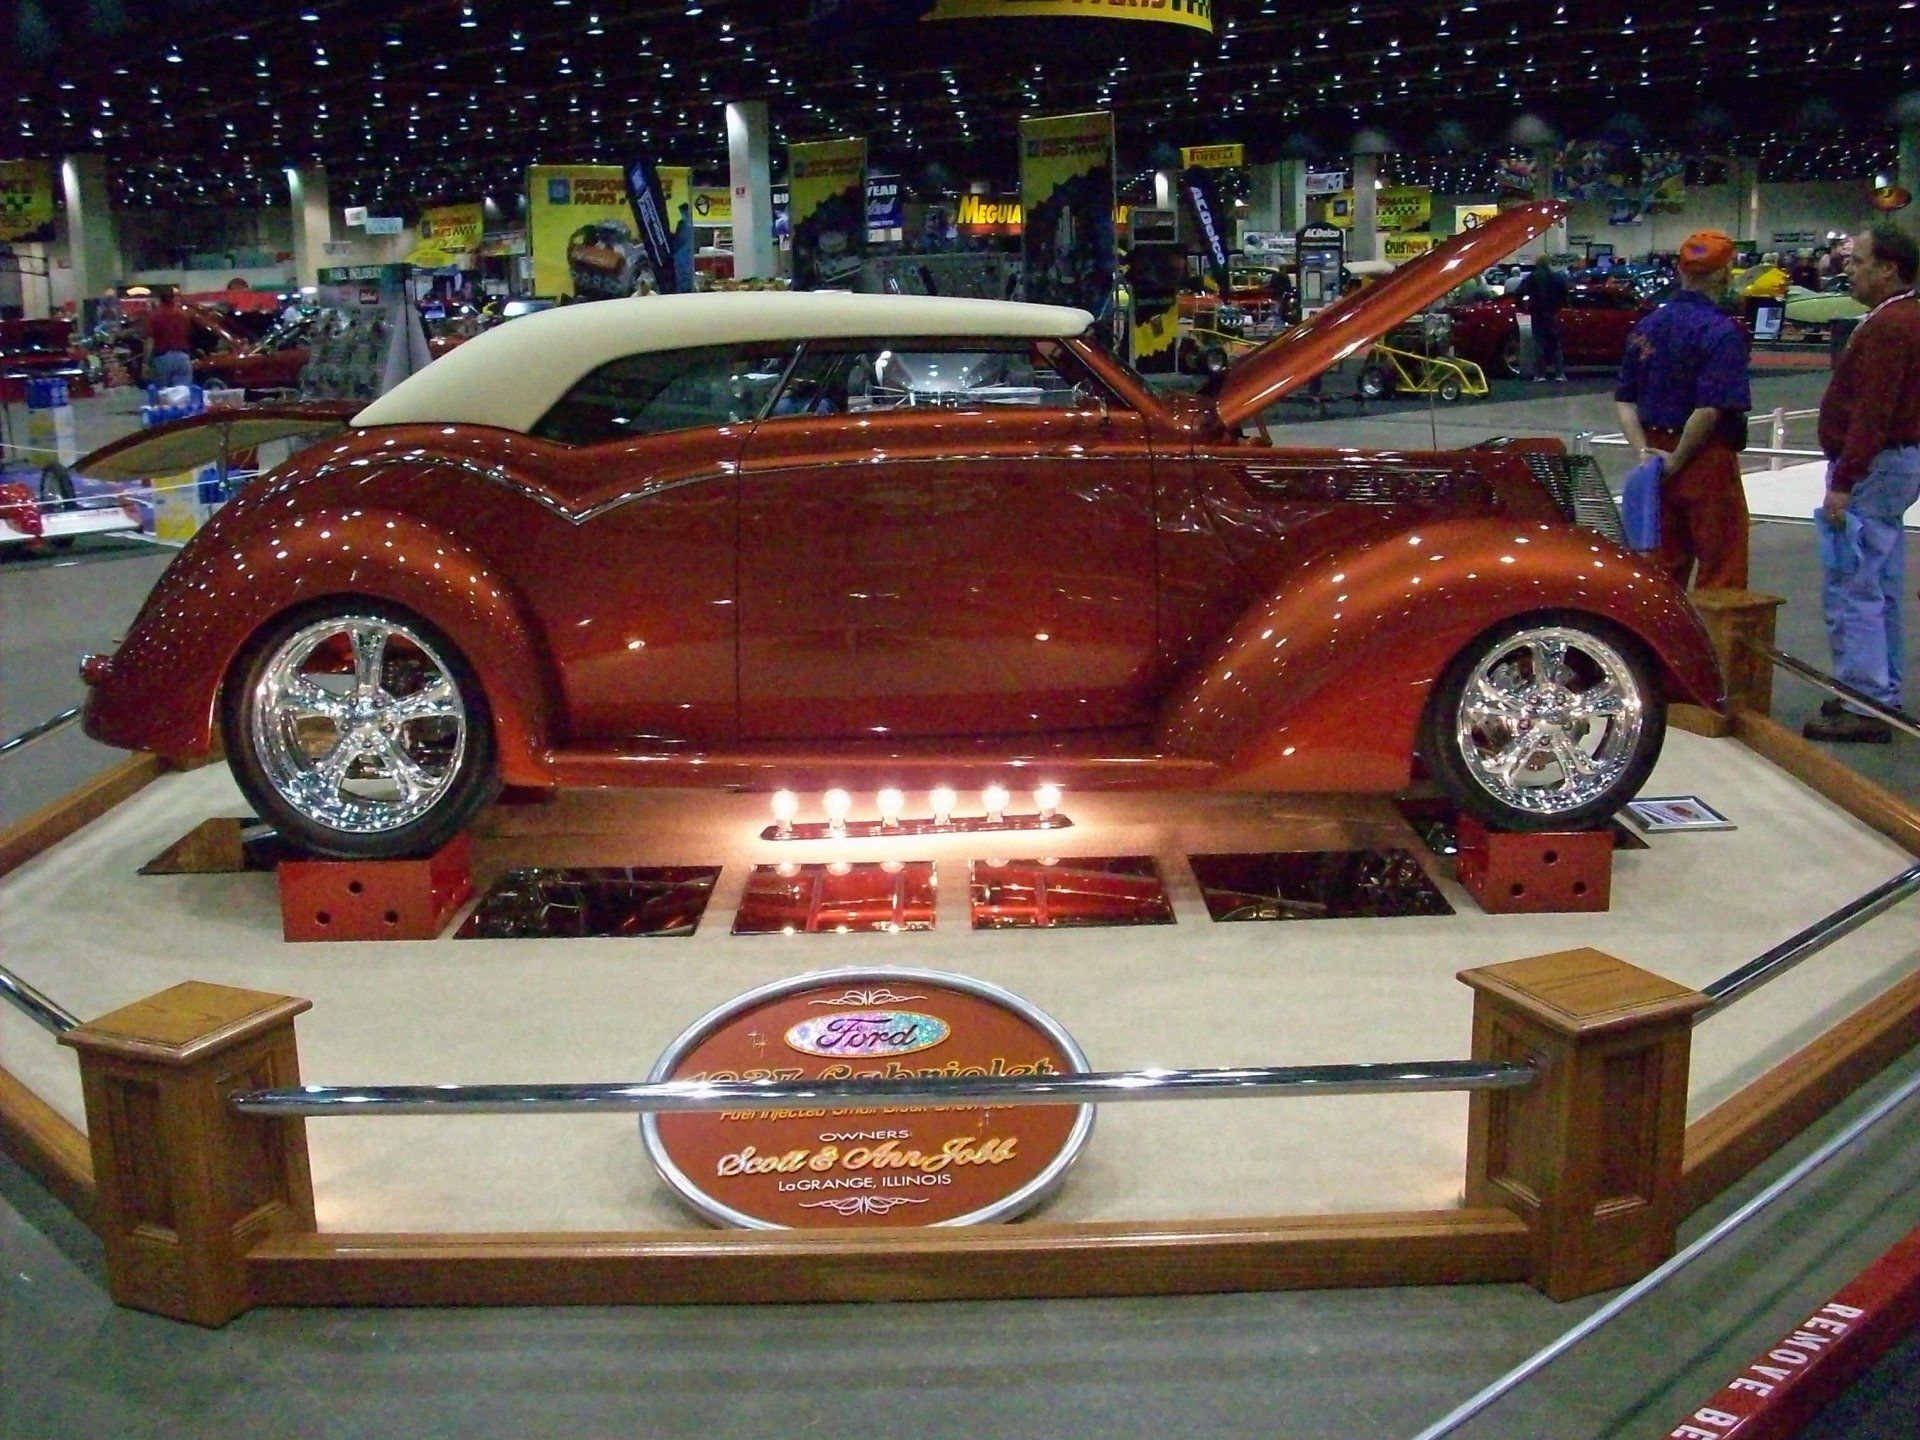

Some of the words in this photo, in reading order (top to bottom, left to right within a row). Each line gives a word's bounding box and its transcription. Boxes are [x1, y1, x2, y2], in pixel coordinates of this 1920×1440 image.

[1190, 149, 1233, 161] PIRELLI
[816, 1018, 918, 1049] Ford
[717, 1145, 811, 1177] Scott
[808, 1145, 839, 1172] &
[841, 1140, 922, 1170] Ann
[778, 1176, 876, 1192] LaGRANGE,
[882, 1174, 952, 1187] ILLINOIS
[1727, 1302, 1865, 1398] REMOVE
